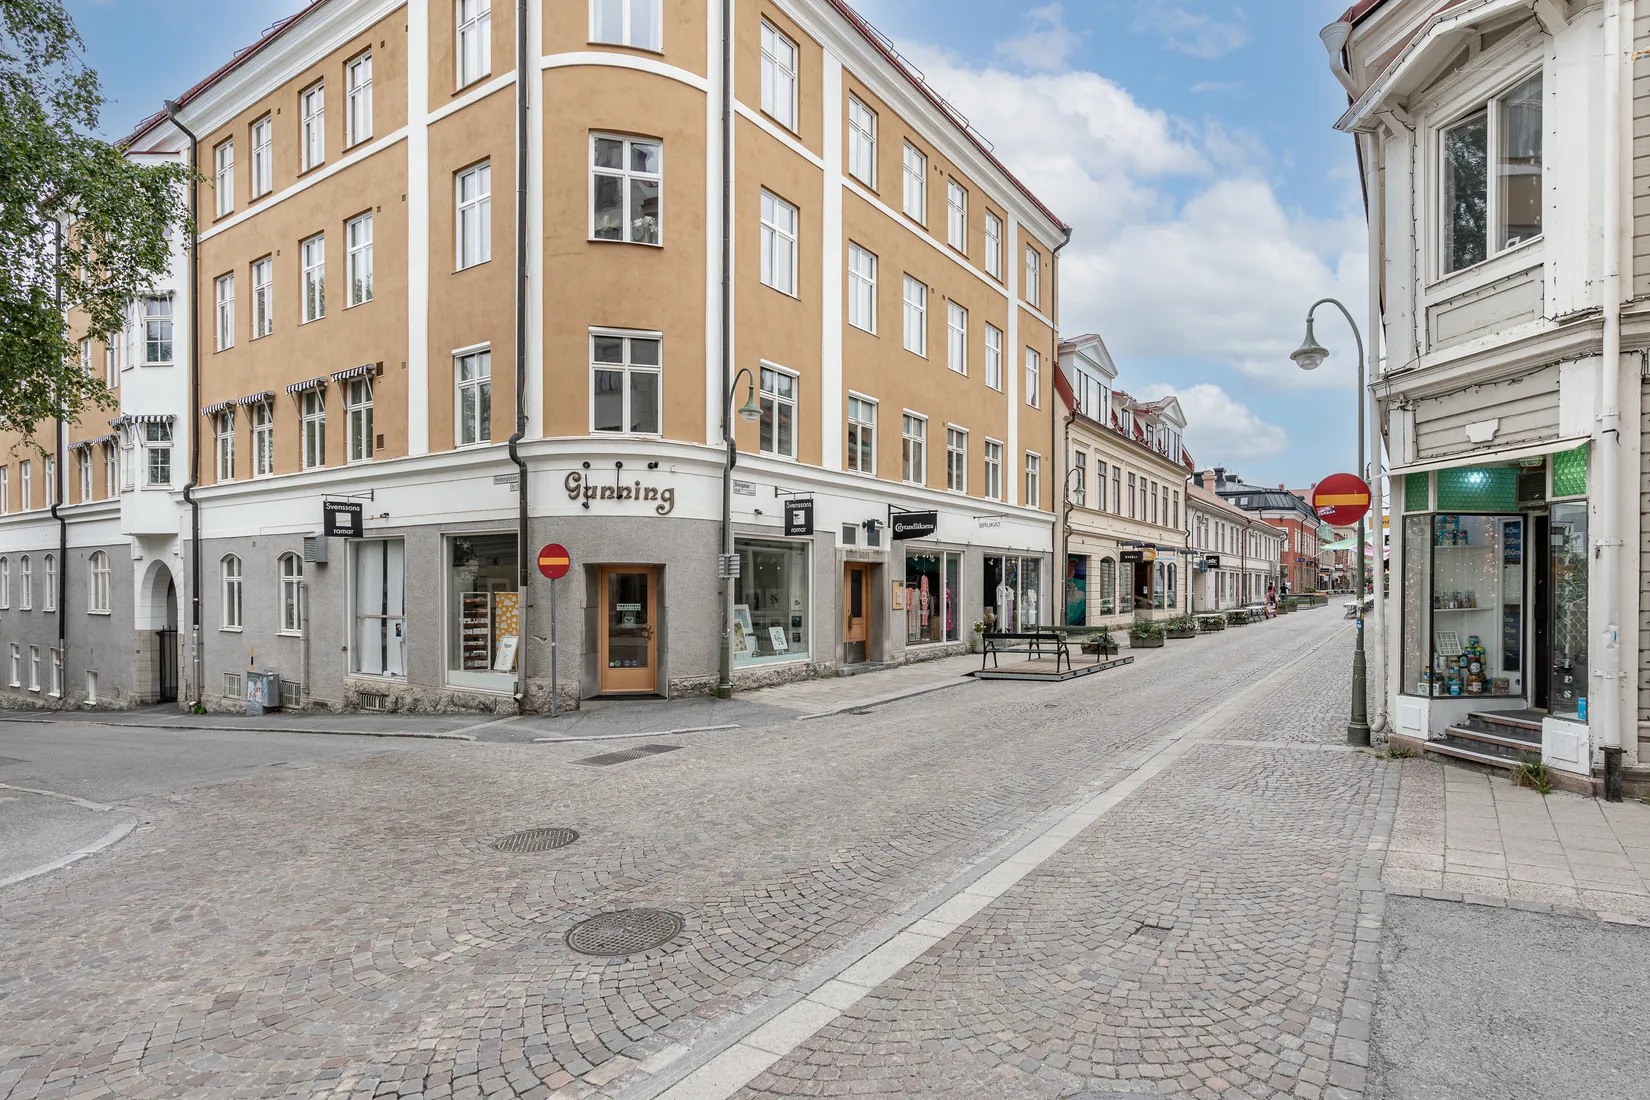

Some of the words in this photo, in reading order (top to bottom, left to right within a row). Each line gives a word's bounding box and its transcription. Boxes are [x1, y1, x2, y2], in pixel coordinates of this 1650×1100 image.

[564, 471, 675, 515] Gunning
[325, 502, 361, 511] Svenssons
[786, 501, 812, 509] Svenssons
[979, 521, 1001, 529] BRUKAT
